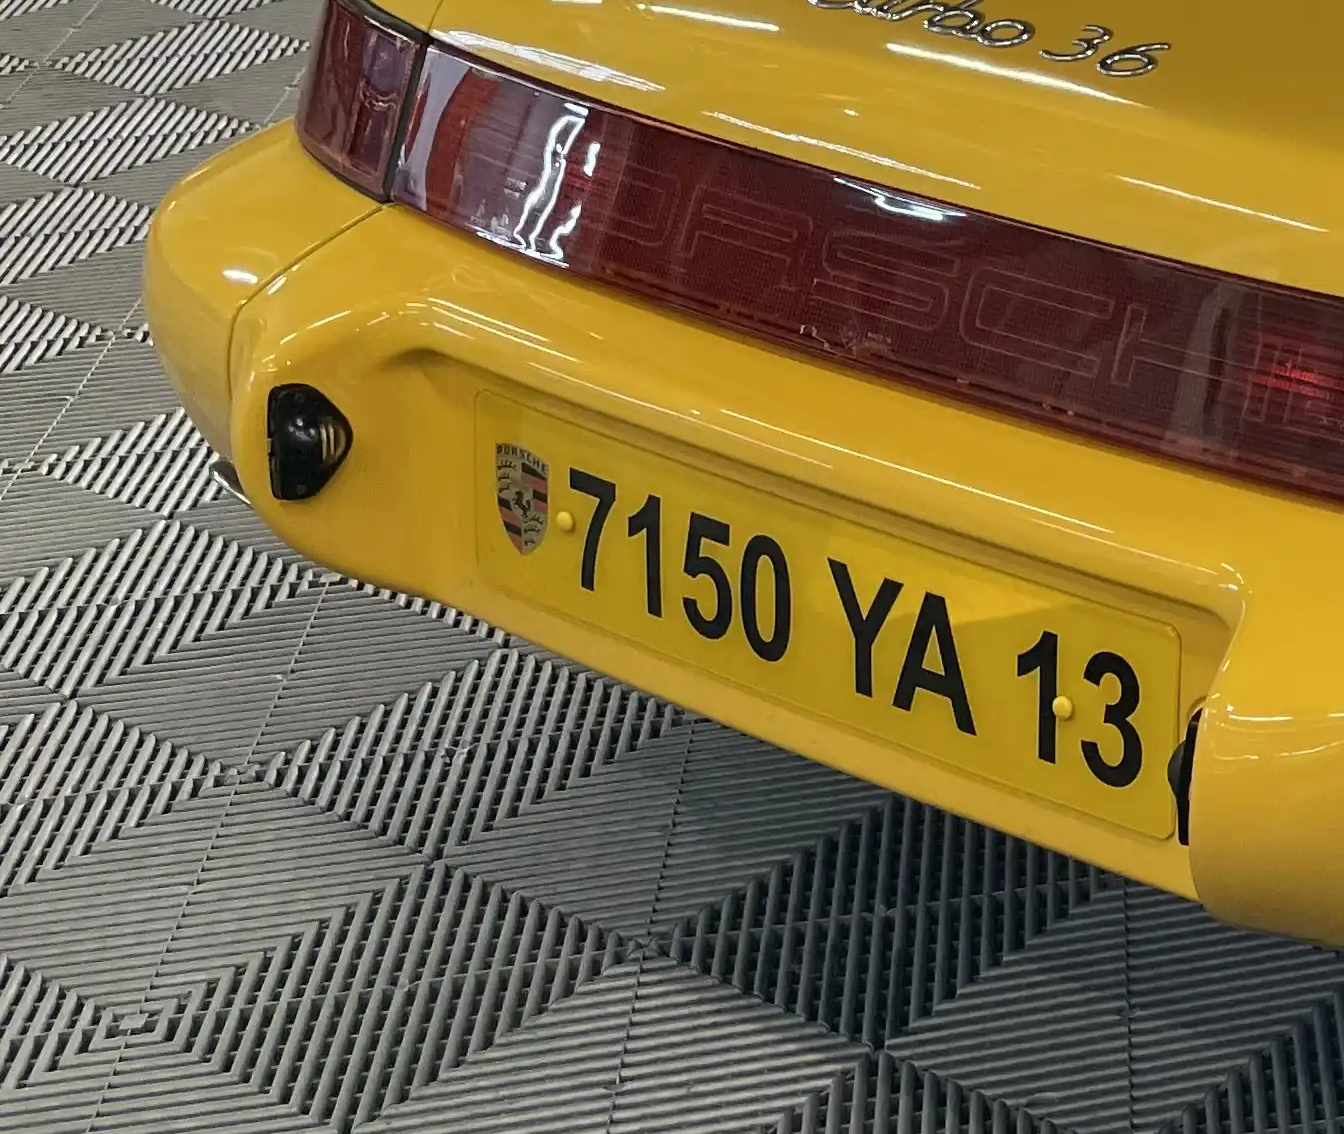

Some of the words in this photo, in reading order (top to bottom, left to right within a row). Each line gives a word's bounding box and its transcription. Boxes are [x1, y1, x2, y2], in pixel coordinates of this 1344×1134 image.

[1038, 24, 1172, 77] 36
[568, 467, 793, 663] 7150
[827, 556, 977, 737] YA
[1015, 630, 1144, 788] 13
